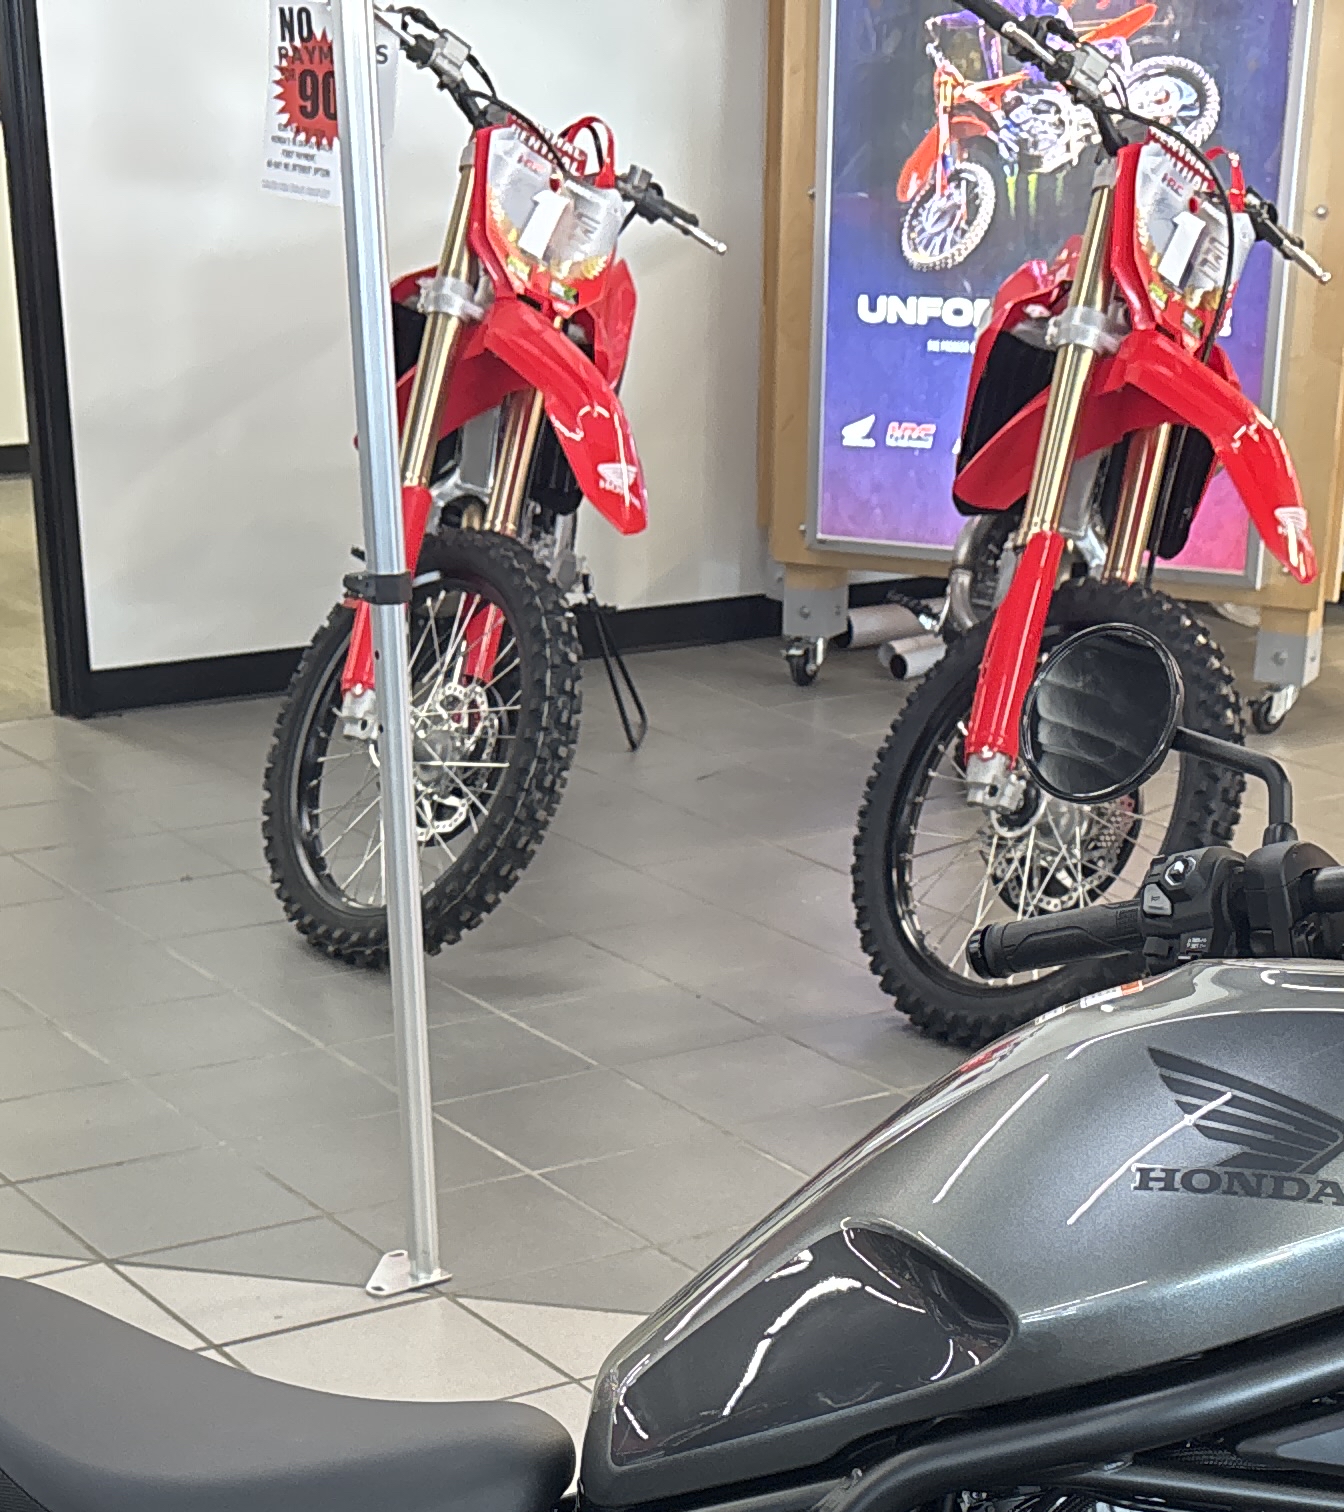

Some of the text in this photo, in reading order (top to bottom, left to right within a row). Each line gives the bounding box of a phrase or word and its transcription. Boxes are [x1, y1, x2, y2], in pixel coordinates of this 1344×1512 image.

[278, 6, 313, 43] NO
[277, 44, 388, 65] PAYMS
[298, 68, 338, 121] 90
